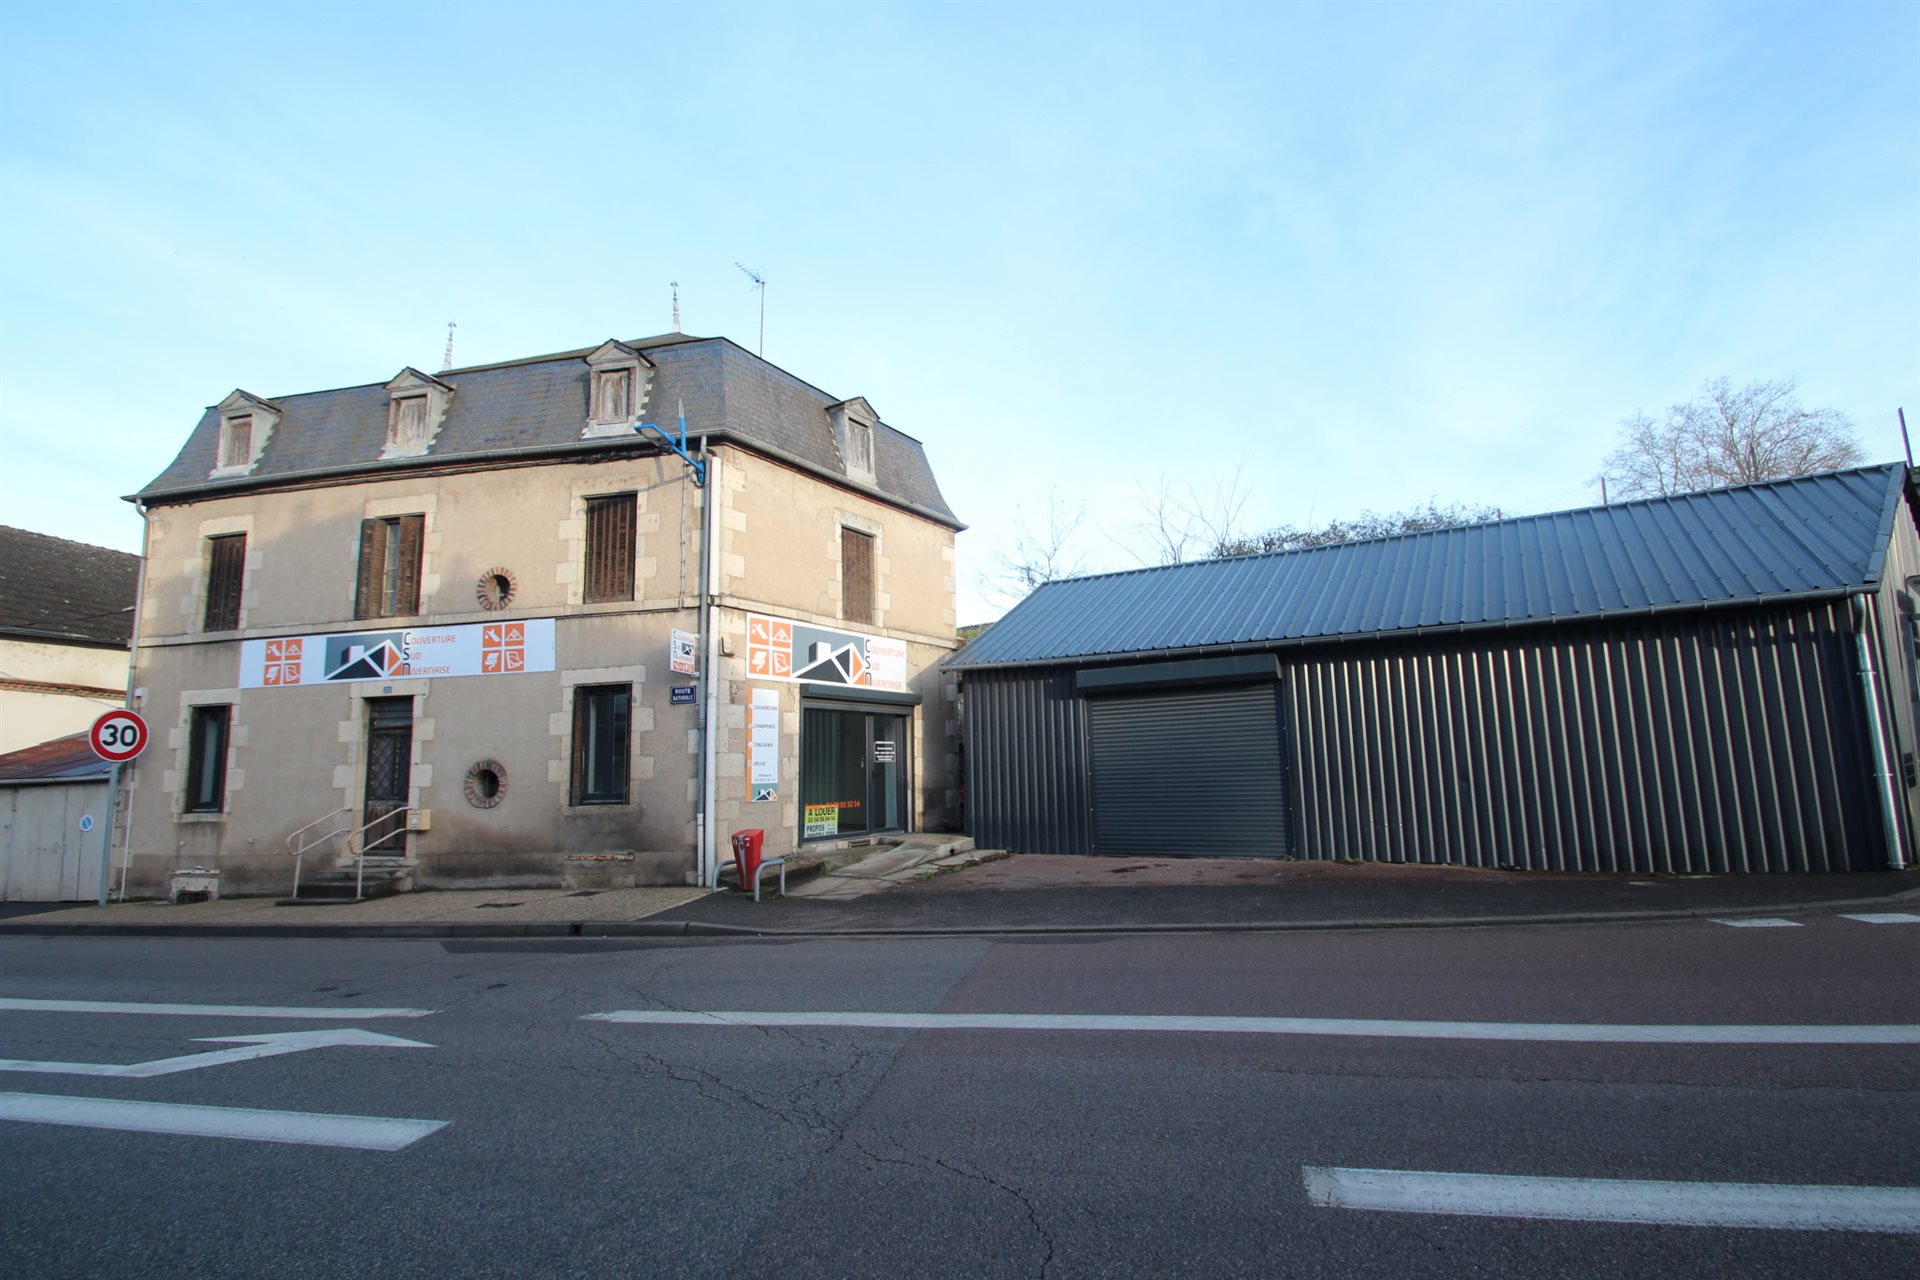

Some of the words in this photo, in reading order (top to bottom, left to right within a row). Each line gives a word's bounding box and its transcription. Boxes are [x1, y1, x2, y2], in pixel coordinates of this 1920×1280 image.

[404, 632, 456, 645] COUVERTURE
[403, 647, 421, 660] SUD
[865, 655, 880, 671] SUD
[102, 724, 137, 747] 30
[815, 807, 836, 816] LOUER
